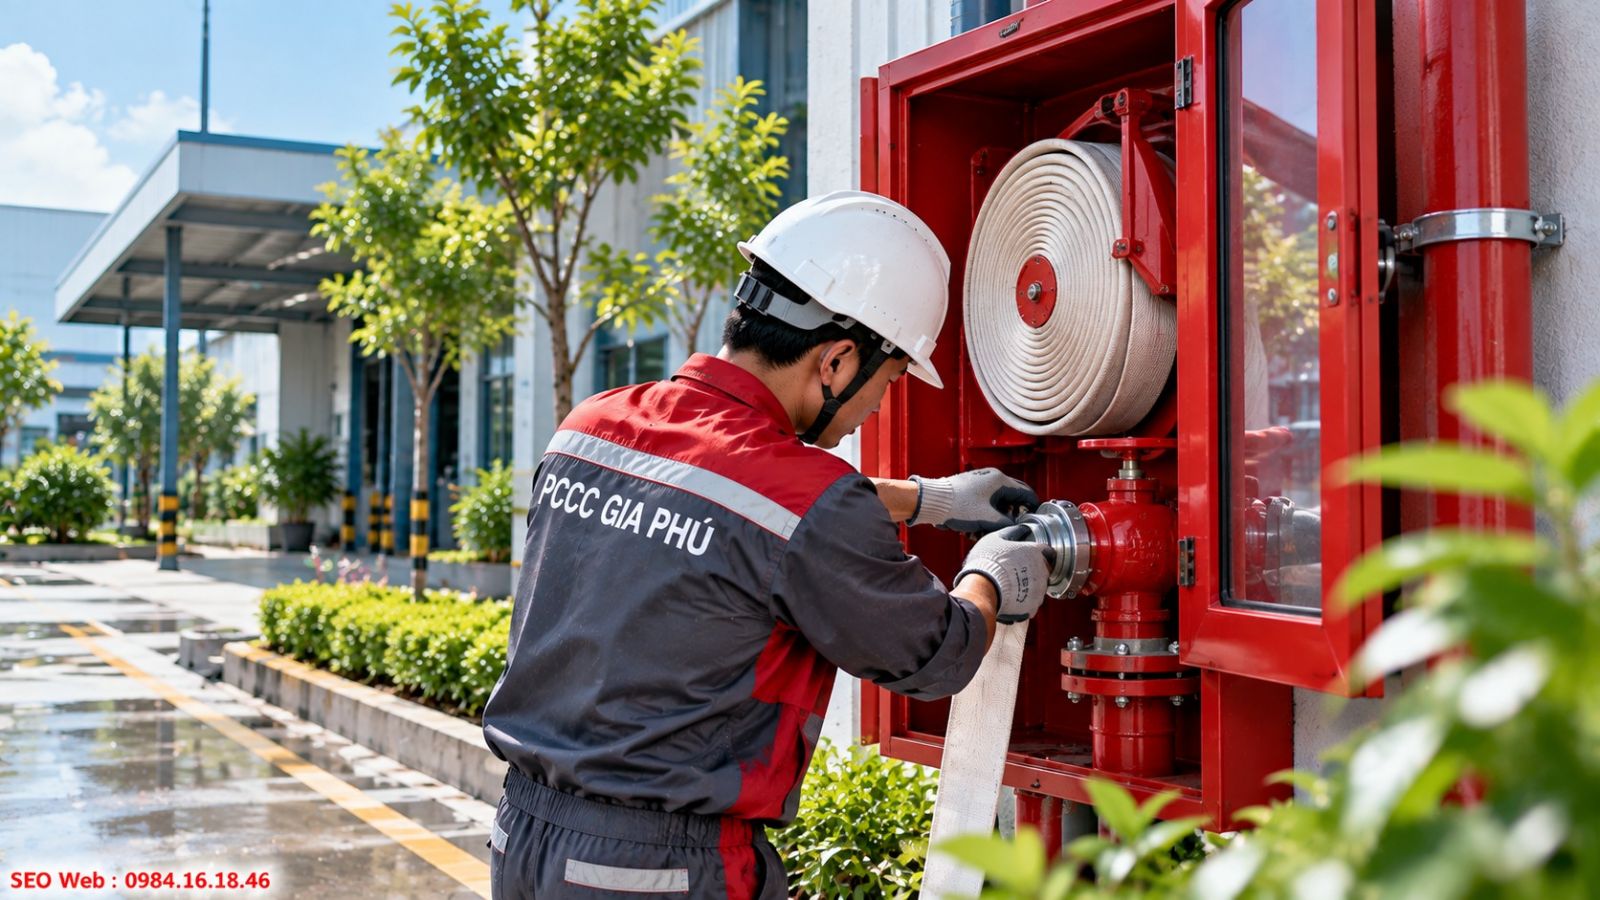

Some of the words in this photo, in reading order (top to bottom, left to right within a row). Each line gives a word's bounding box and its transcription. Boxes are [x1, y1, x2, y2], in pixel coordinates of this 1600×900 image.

[538, 474, 600, 519] PCCC
[601, 494, 645, 534] GIA
[646, 507, 715, 556] PHÚ
